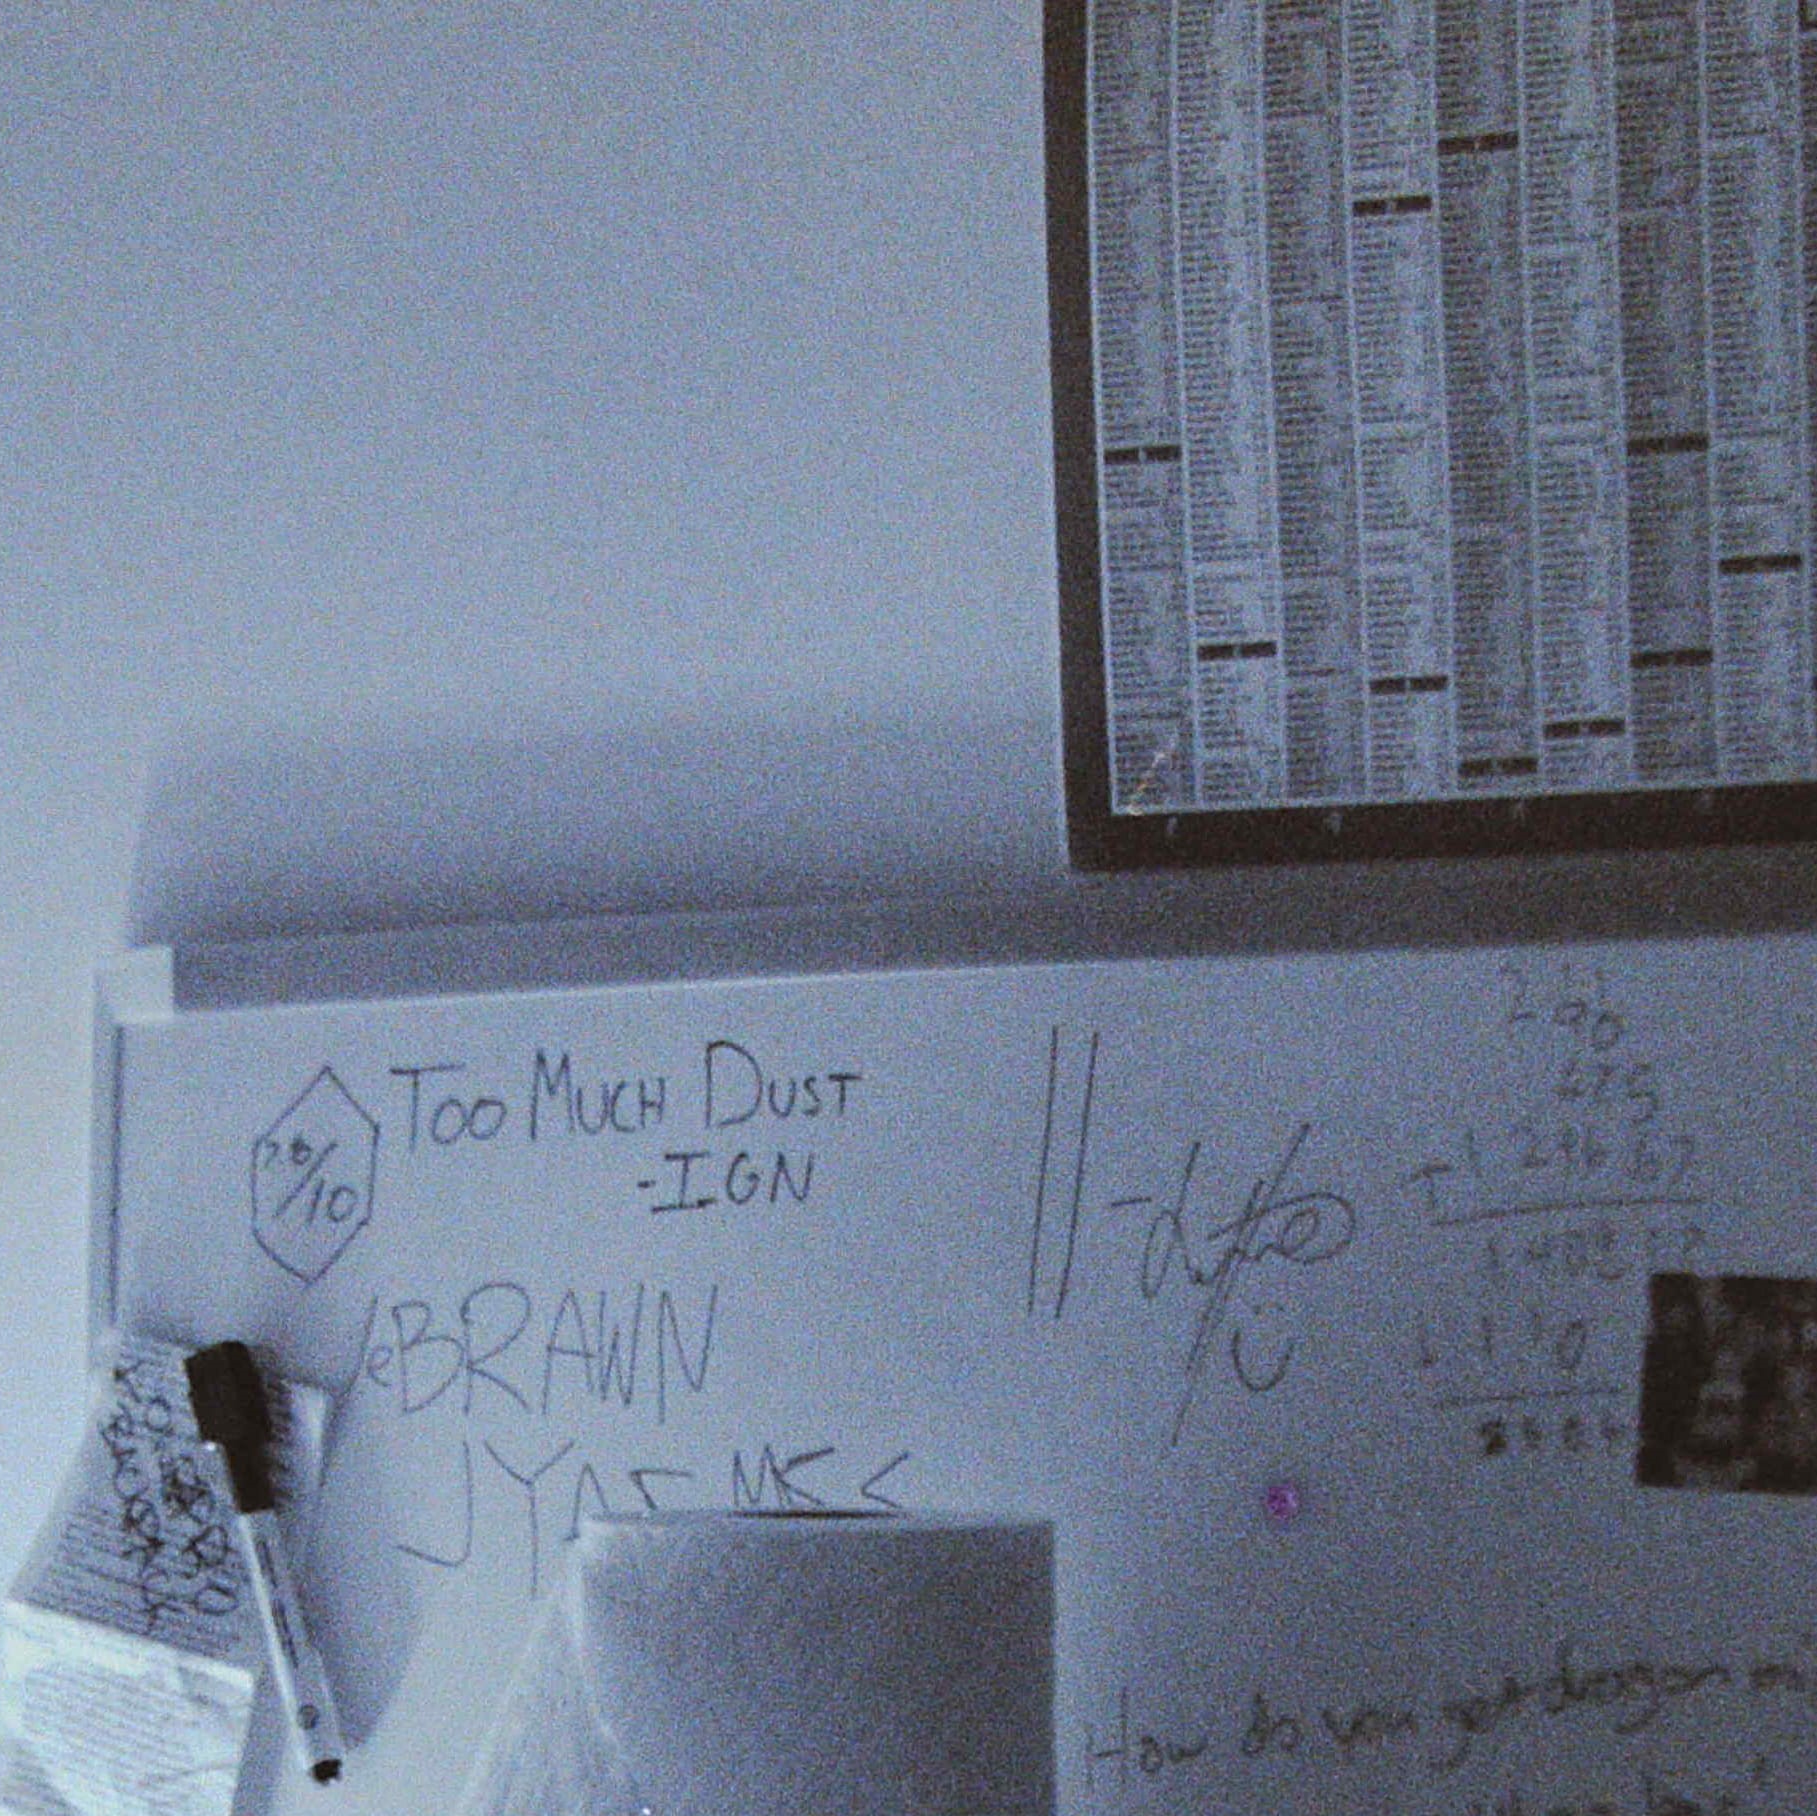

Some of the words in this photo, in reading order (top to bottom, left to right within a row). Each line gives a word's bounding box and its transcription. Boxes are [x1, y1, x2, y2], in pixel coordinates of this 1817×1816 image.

[529, 1049, 667, 1141] MUCH
[704, 1040, 863, 1128] DUST
[1085, 1686, 1209, 1792] How
[1239, 1692, 1299, 1757] do
[1320, 1698, 1418, 1764] you
